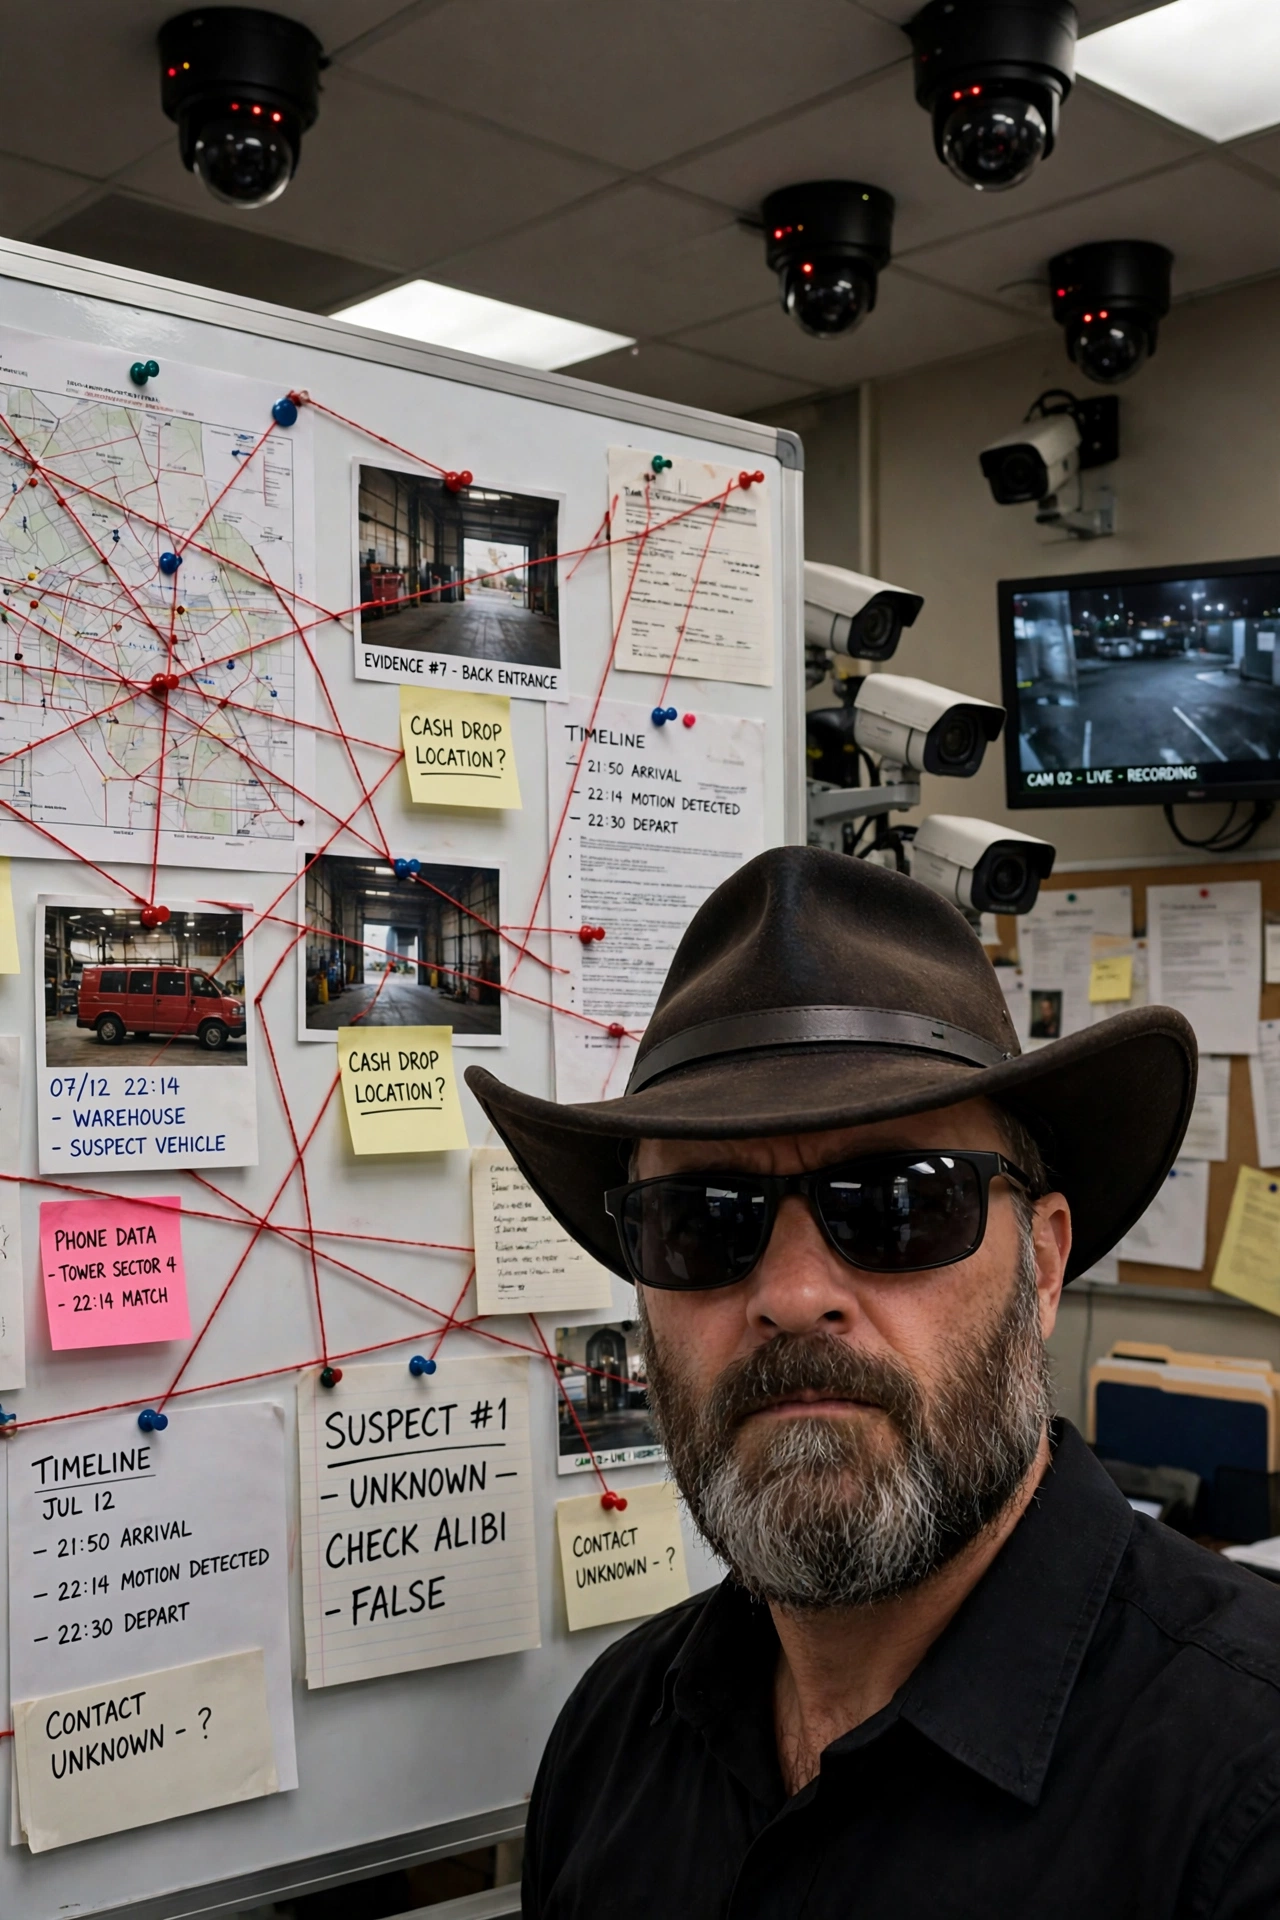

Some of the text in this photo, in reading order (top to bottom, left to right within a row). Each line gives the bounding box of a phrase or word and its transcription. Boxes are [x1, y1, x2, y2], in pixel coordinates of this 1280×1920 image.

[364, 652, 424, 674] EVIDENCE
[428, 661, 447, 677] #7
[462, 665, 493, 683] BACK
[498, 669, 558, 690] ENTRANCE
[410, 715, 502, 741] CASH DROP
[564, 725, 646, 749] TIMELINE
[415, 745, 506, 771] LOCATION?
[587, 760, 624, 775] 21:50
[631, 764, 682, 783] ARRIVAL
[1027, 772, 1054, 787] CAM
[1057, 771, 1073, 786] 02
[1086, 769, 1113, 784] LIVE
[1127, 766, 1197, 783] RECORDING
[588, 787, 623, 803] 22:14
[631, 792, 675, 808] MOTION
[682, 797, 741, 816] DETECTED
[588, 815, 625, 829] 22:30
[633, 817, 679, 834] DEPART
[348, 1050, 439, 1073] CASH DROP
[50, 1072, 180, 1102] 07/12 22:14
[355, 1076, 445, 1103] LOCATION?
[72, 1107, 186, 1127] WAREHOUSE
[70, 1136, 147, 1157] SUSPECT
[155, 1134, 226, 1154] VEHICLE
[54, 1225, 157, 1252] PHONE DATA
[58, 1262, 106, 1282] TOWER
[112, 1257, 161, 1277] SECTOR
[166, 1256, 177, 1273] 4
[73, 1292, 114, 1312] 22:14
[122, 1287, 168, 1307] MATCH
[325, 1397, 507, 1450] SUSPECT #1
[31, 1446, 151, 1484] TIMELINE
[350, 1460, 486, 1508] UNKNOWN
[42, 1491, 115, 1521] JUL 12
[57, 1532, 110, 1558] 21:50
[120, 1520, 192, 1548] ARRIVAL
[325, 1511, 505, 1569] CHECK ALIBI
[572, 1527, 638, 1557] CONTACT
[58, 1575, 110, 1601] 22:14
[120, 1563, 180, 1590] MOTION
[189, 1548, 270, 1578] DETECTED
[576, 1556, 647, 1588] UNKNOWN
[665, 1546, 675, 1571] ?
[352, 1575, 446, 1626] FALSE
[58, 1618, 113, 1645] 22:30
[124, 1602, 190, 1633] DEPART
[45, 1691, 146, 1740] CONTACT
[51, 1723, 164, 1779] UNKNOWN
[198, 1706, 212, 1739] ?
